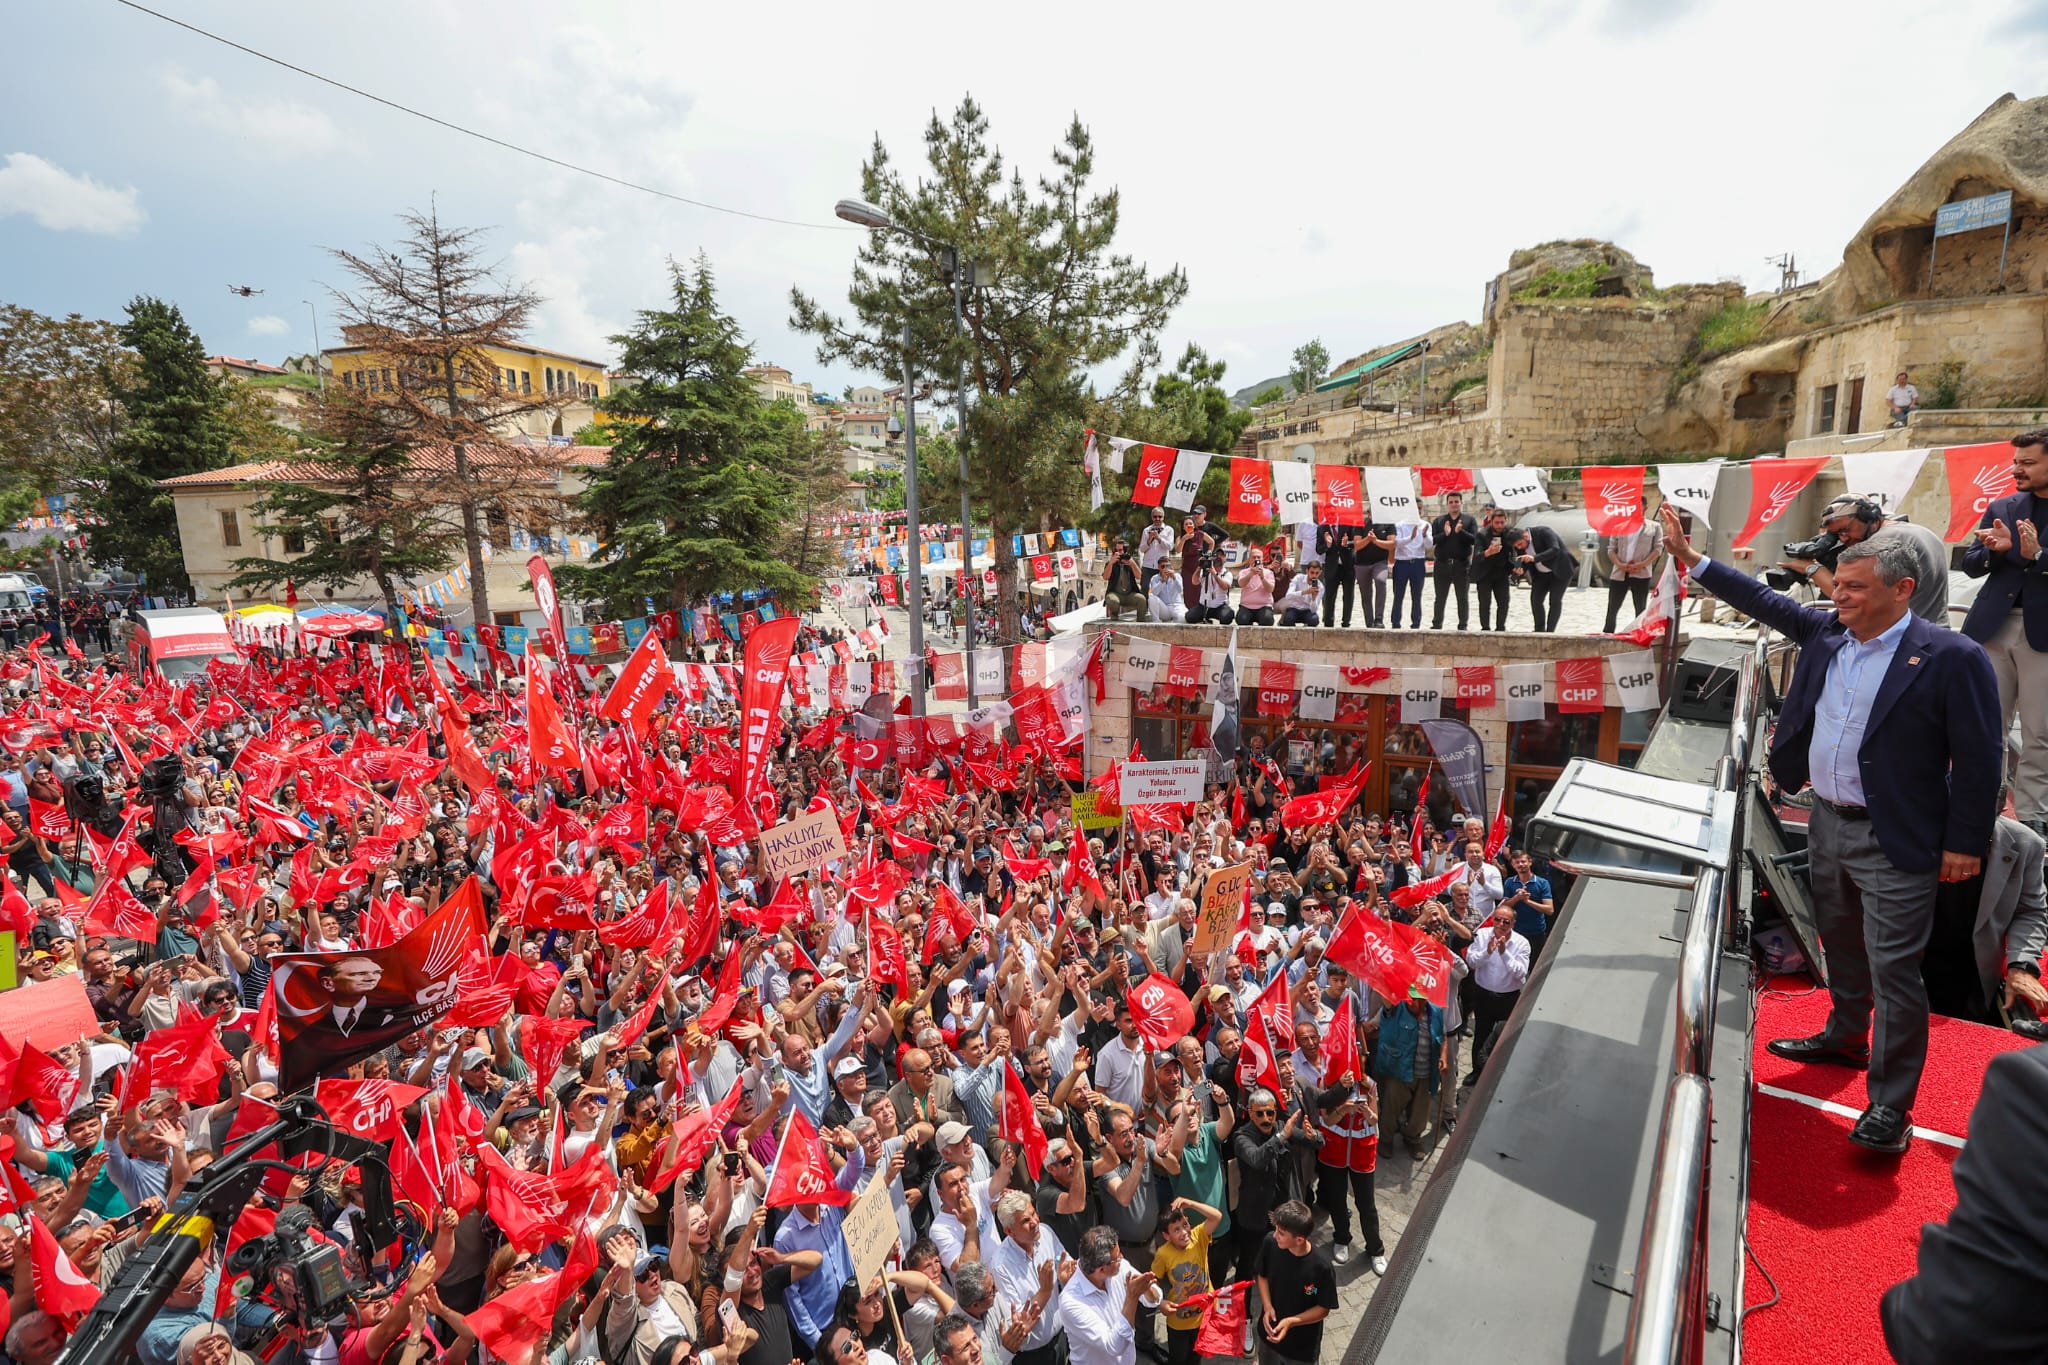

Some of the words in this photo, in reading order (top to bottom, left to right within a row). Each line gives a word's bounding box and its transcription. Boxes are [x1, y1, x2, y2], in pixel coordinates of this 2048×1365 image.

[1144, 477, 1161, 488] CHP
[1175, 479, 1199, 494] CHP
[1285, 491, 1310, 504] CHP
[1501, 484, 1537, 498] CHP
[1240, 492, 1262, 505] CHP
[1330, 497, 1355, 508] CHP
[1380, 496, 1410, 508] CHP
[1602, 503, 1637, 518] CHP
[1128, 656, 1155, 671] CHP
[1169, 674, 1195, 688] CHP
[1618, 672, 1655, 689] CHP
[1304, 685, 1336, 700] CHP
[1405, 690, 1439, 702] CHP
[1458, 684, 1492, 697] CHP
[1508, 684, 1542, 698] CHP
[1562, 688, 1598, 702] CHP
[1261, 691, 1289, 705] CHP
[135, 714, 156, 722] CHP
[1150, 779, 1176, 787] Yolumuz
[40, 826, 69, 837] CHP
[765, 822, 826, 855] HAKLIYIZ
[770, 837, 836, 871] KAZANDIK
[1364, 931, 1394, 966] CHP
[1141, 983, 1165, 1010] CHP
[352, 1095, 392, 1132] CHP
[796, 1171, 827, 1196] CHP
